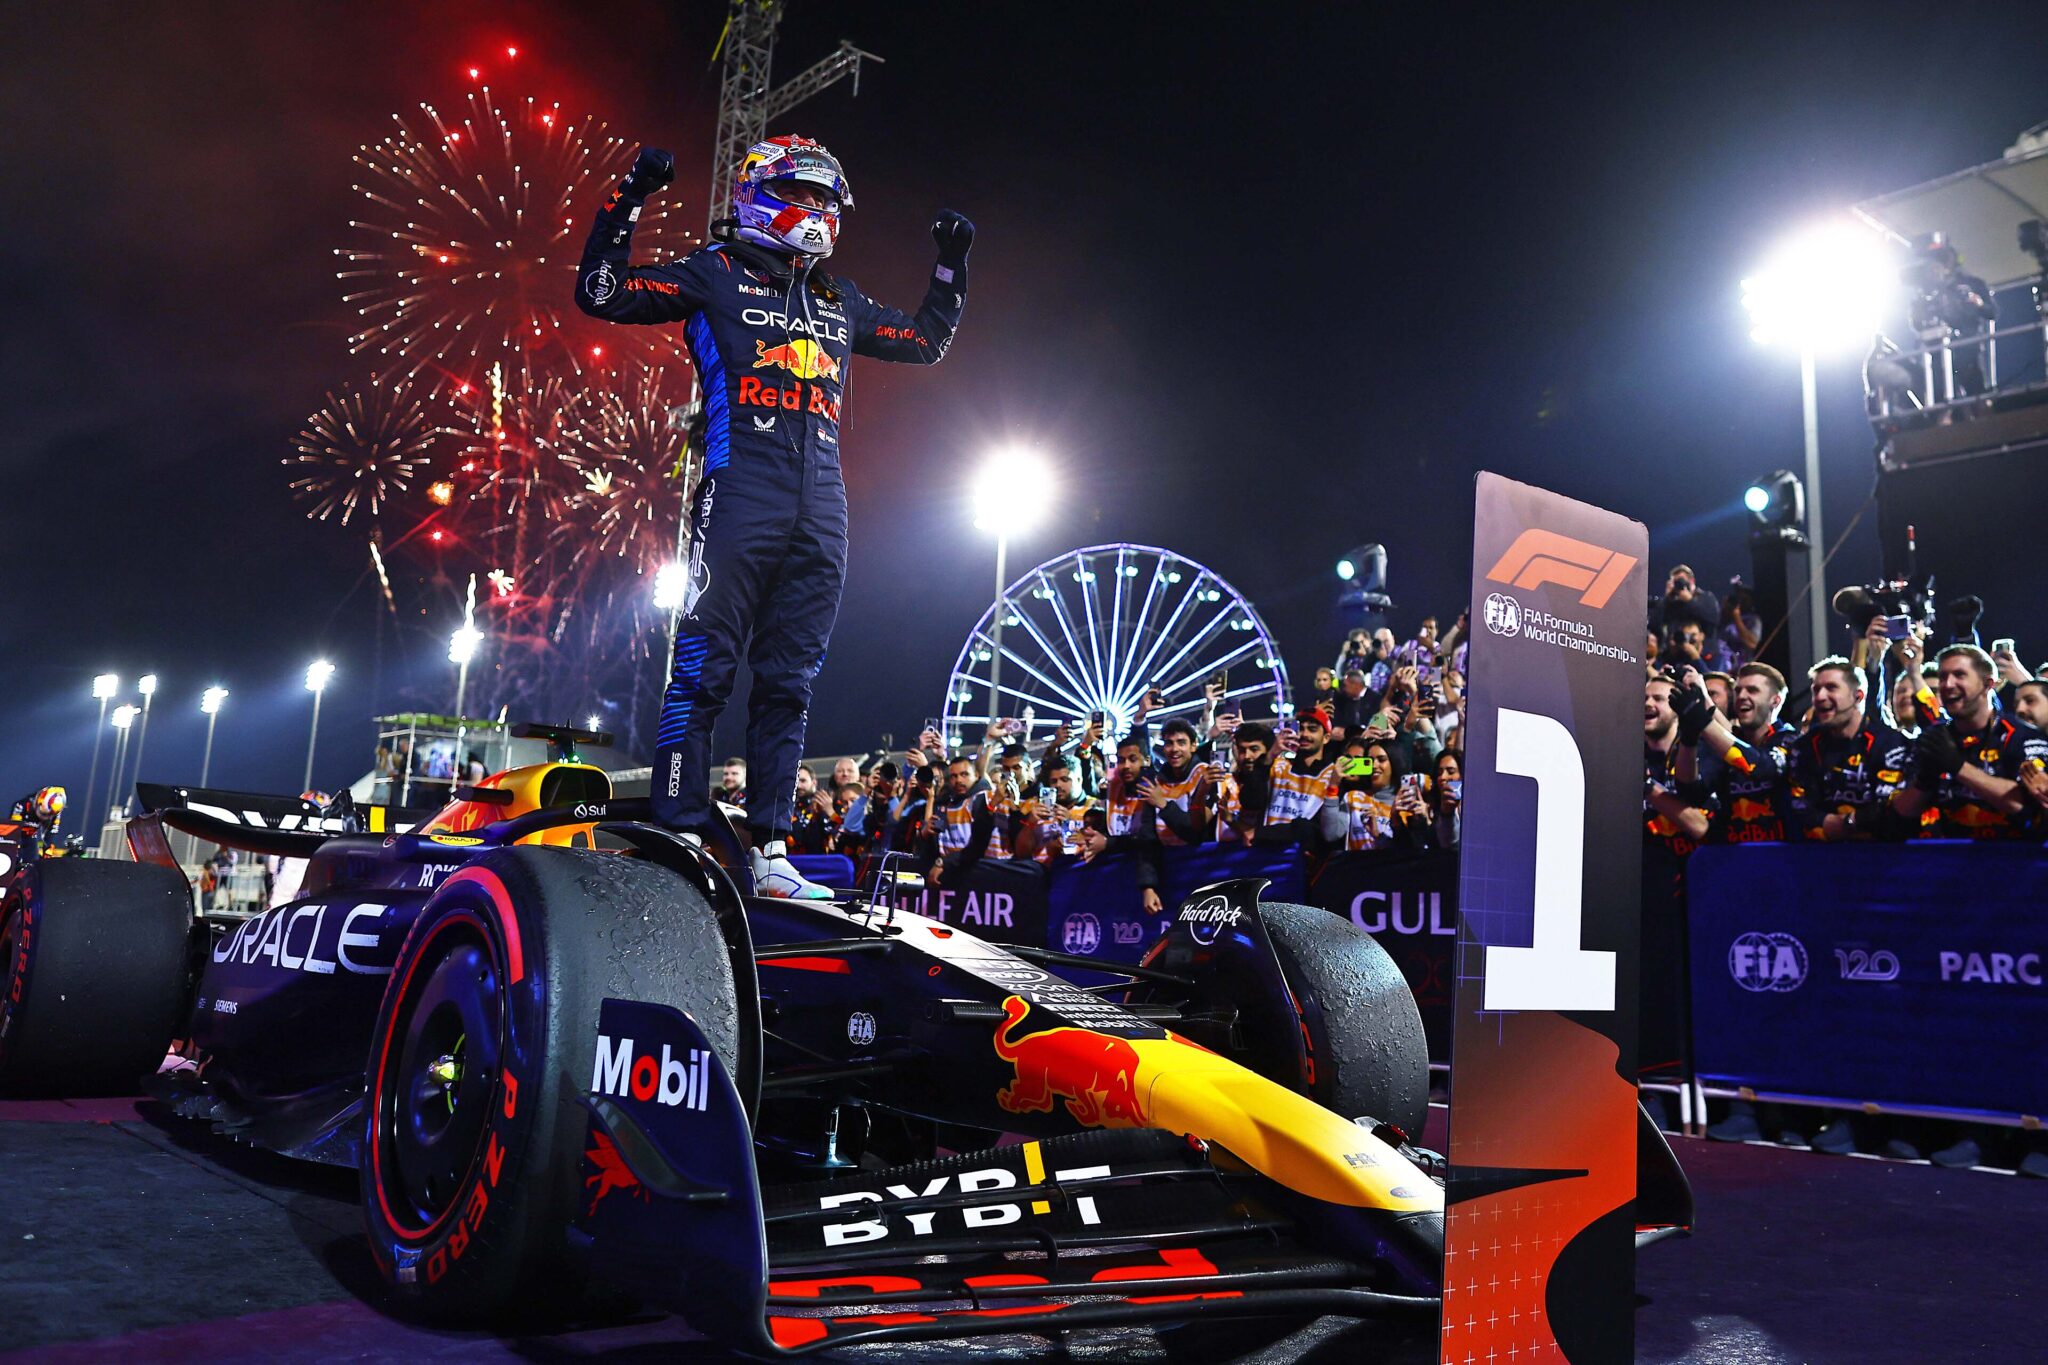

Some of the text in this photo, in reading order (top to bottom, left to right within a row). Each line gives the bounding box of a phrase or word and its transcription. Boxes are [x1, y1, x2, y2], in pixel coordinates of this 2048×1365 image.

[802, 228, 824, 242] EA
[738, 284, 770, 297] Mobil
[741, 308, 848, 346] ORACLE
[817, 310, 848, 324] HONDA
[738, 376, 803, 411] Red
[1523, 607, 1595, 638] FIA Formula 1
[1523, 623, 1557, 645] World
[1557, 632, 1630, 663] Championship
[669, 751, 683, 798] sparco
[588, 804, 607, 817] Sui
[1484, 707, 1617, 1011] 1
[961, 889, 1014, 928] AIR
[1178, 903, 1243, 927] Hard Rock
[213, 903, 395, 975] ORACLE
[1112, 922, 1144, 944] 120
[1834, 948, 1900, 981] 120
[1939, 950, 2043, 986] PARC
[1004, 983, 1082, 992] zoom
[214, 999, 238, 1015] SIEMENS
[1073, 1020, 1132, 1028] Mobil
[591, 1034, 711, 1111] Mobil
[427, 1067, 518, 1285] P ZERO
